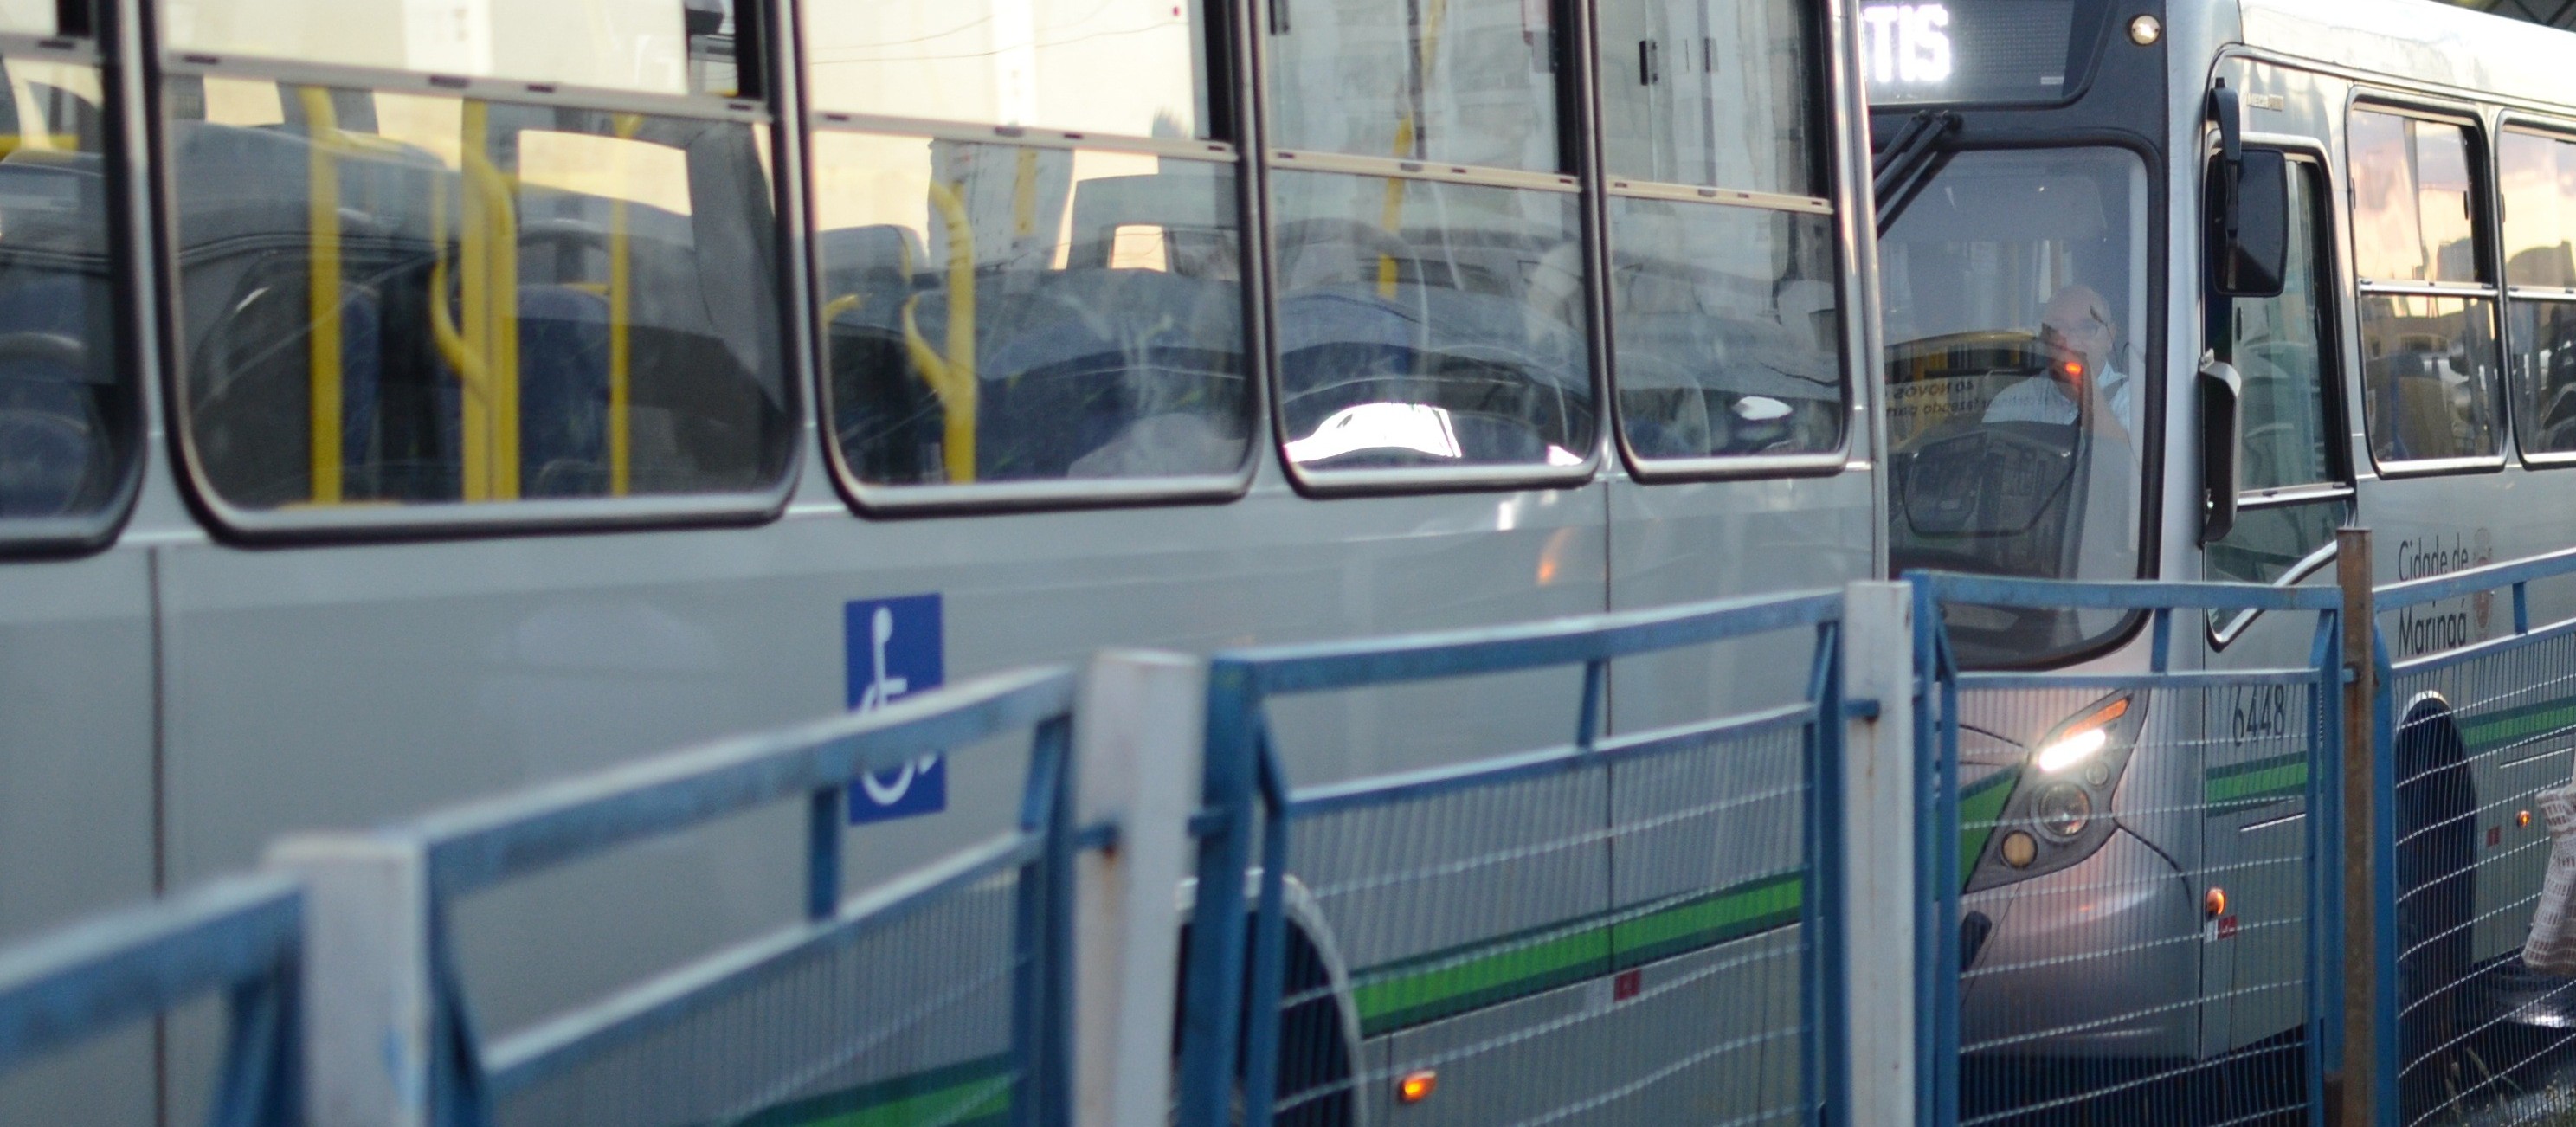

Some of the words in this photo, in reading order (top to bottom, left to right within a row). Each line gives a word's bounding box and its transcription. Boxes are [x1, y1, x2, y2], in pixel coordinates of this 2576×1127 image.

[1864, 4, 1950, 83] TIS
[2398, 536, 2448, 582] Cidade
[2452, 531, 2469, 573] de
[2232, 683, 2285, 747] 6448
